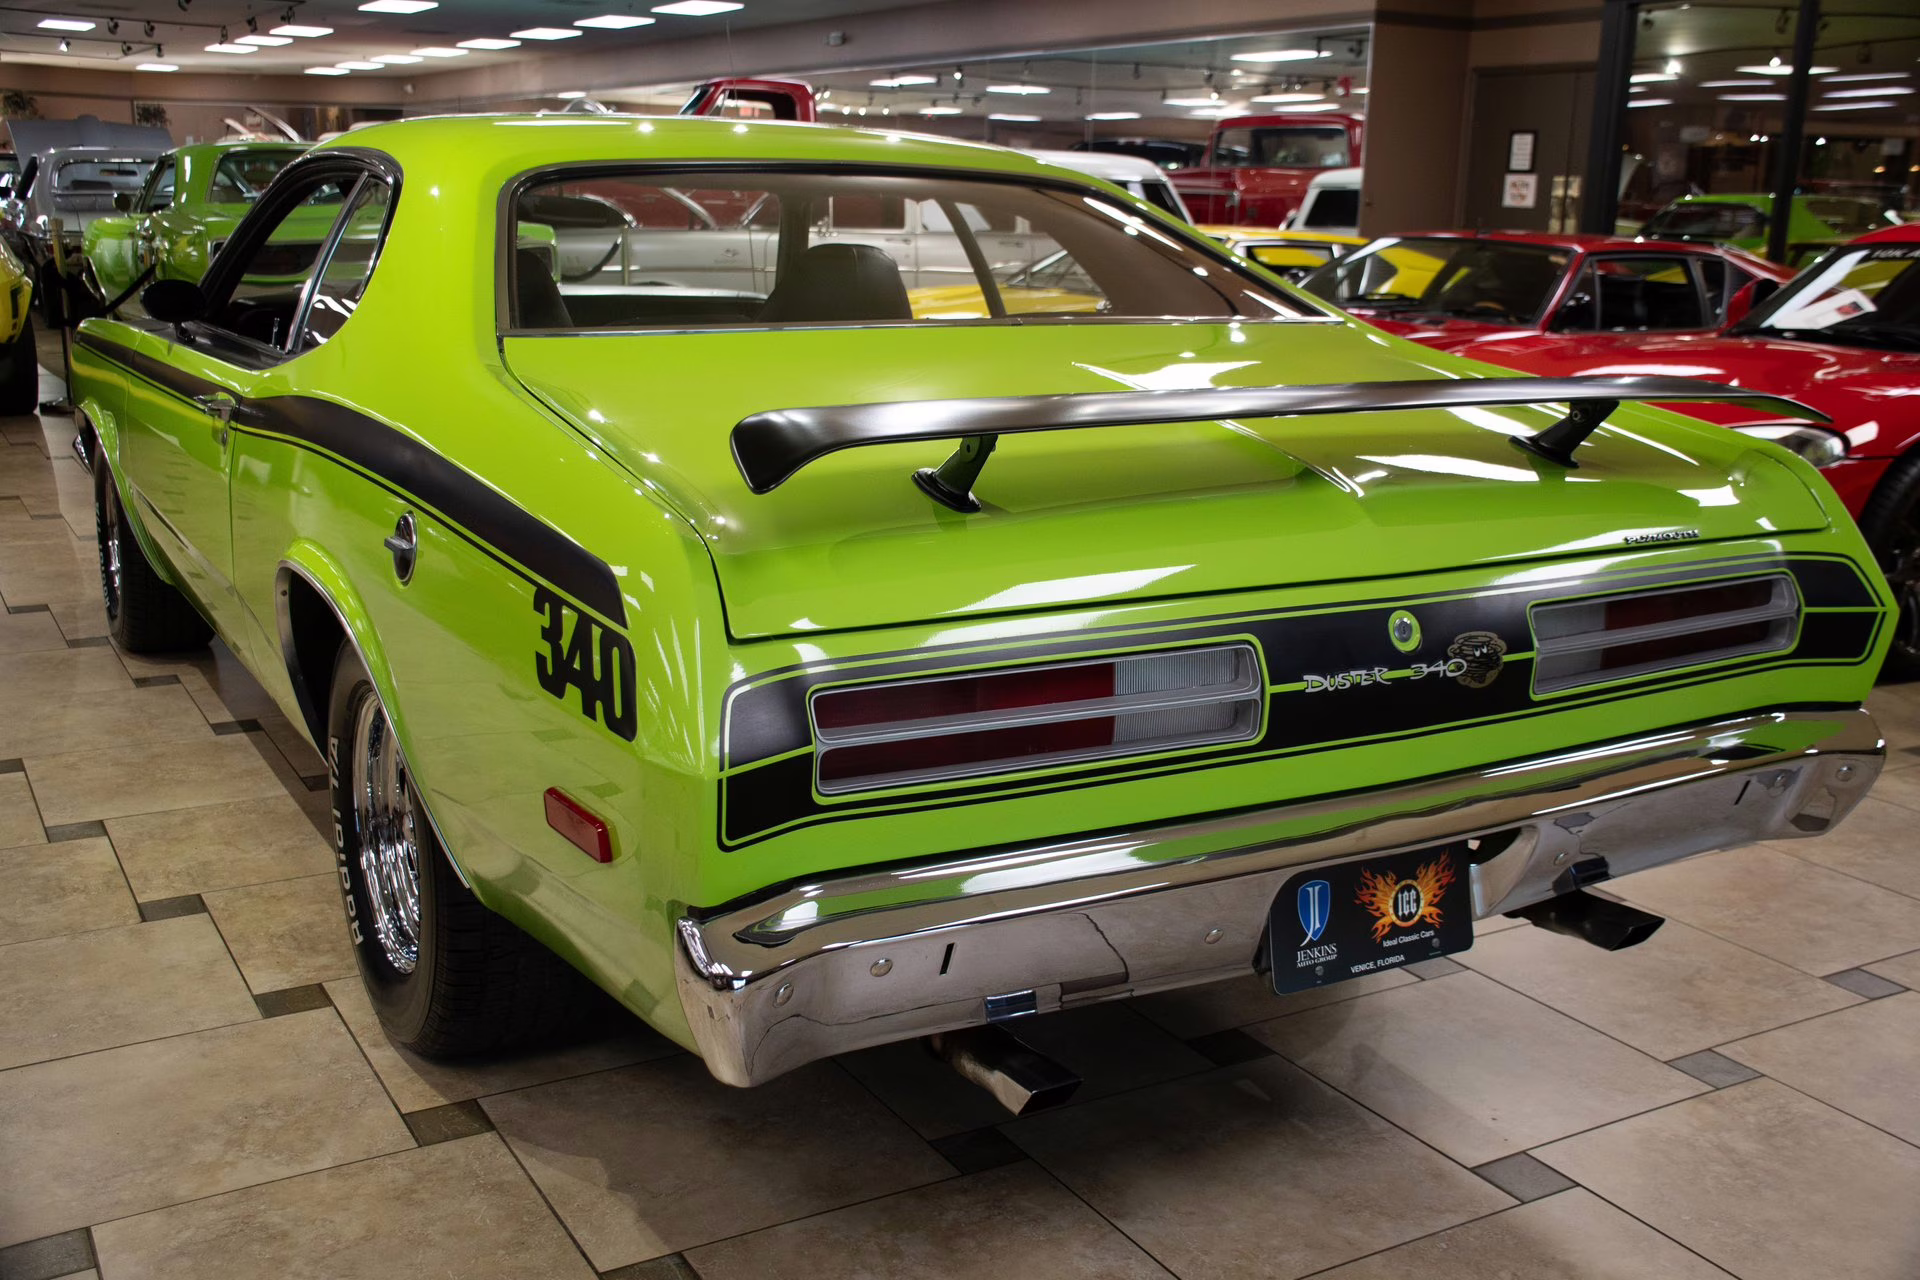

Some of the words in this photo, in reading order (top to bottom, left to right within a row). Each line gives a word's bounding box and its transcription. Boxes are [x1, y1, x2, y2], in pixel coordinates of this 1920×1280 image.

[534, 587, 638, 742] 340
[1303, 667, 1392, 693] DUSTER
[1410, 658, 1467, 680] 340
[332, 808, 364, 946] Radial
[1398, 888, 1417, 917] ICC
[1382, 938, 1398, 948] Ideal
[1398, 933, 1420, 945] Classic
[1420, 930, 1435, 940] Cars
[1296, 943, 1338, 963] JENKINS
[1296, 959, 1314, 969] AUTO
[1315, 954, 1338, 964] GROUP
[1350, 961, 1377, 974] VENICE,
[1377, 954, 1406, 967] FLORIDA
